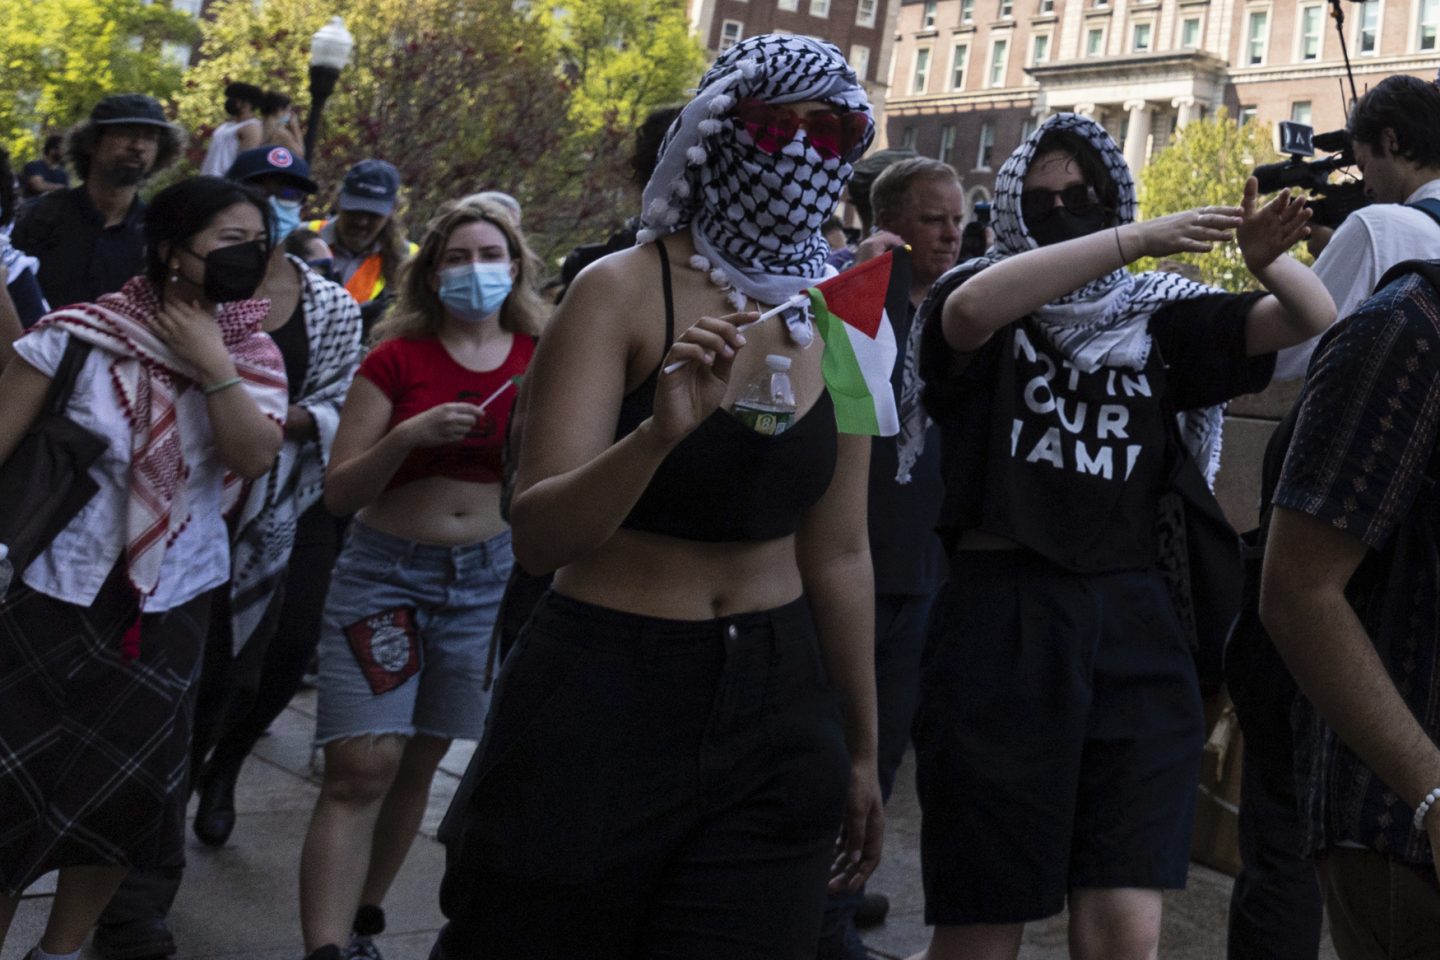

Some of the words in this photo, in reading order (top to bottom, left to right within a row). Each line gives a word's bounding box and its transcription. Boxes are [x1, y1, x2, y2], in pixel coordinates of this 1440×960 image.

[1024, 375, 1130, 439] OUR
[1106, 369, 1152, 397] IN
[1011, 418, 1142, 482] AM
